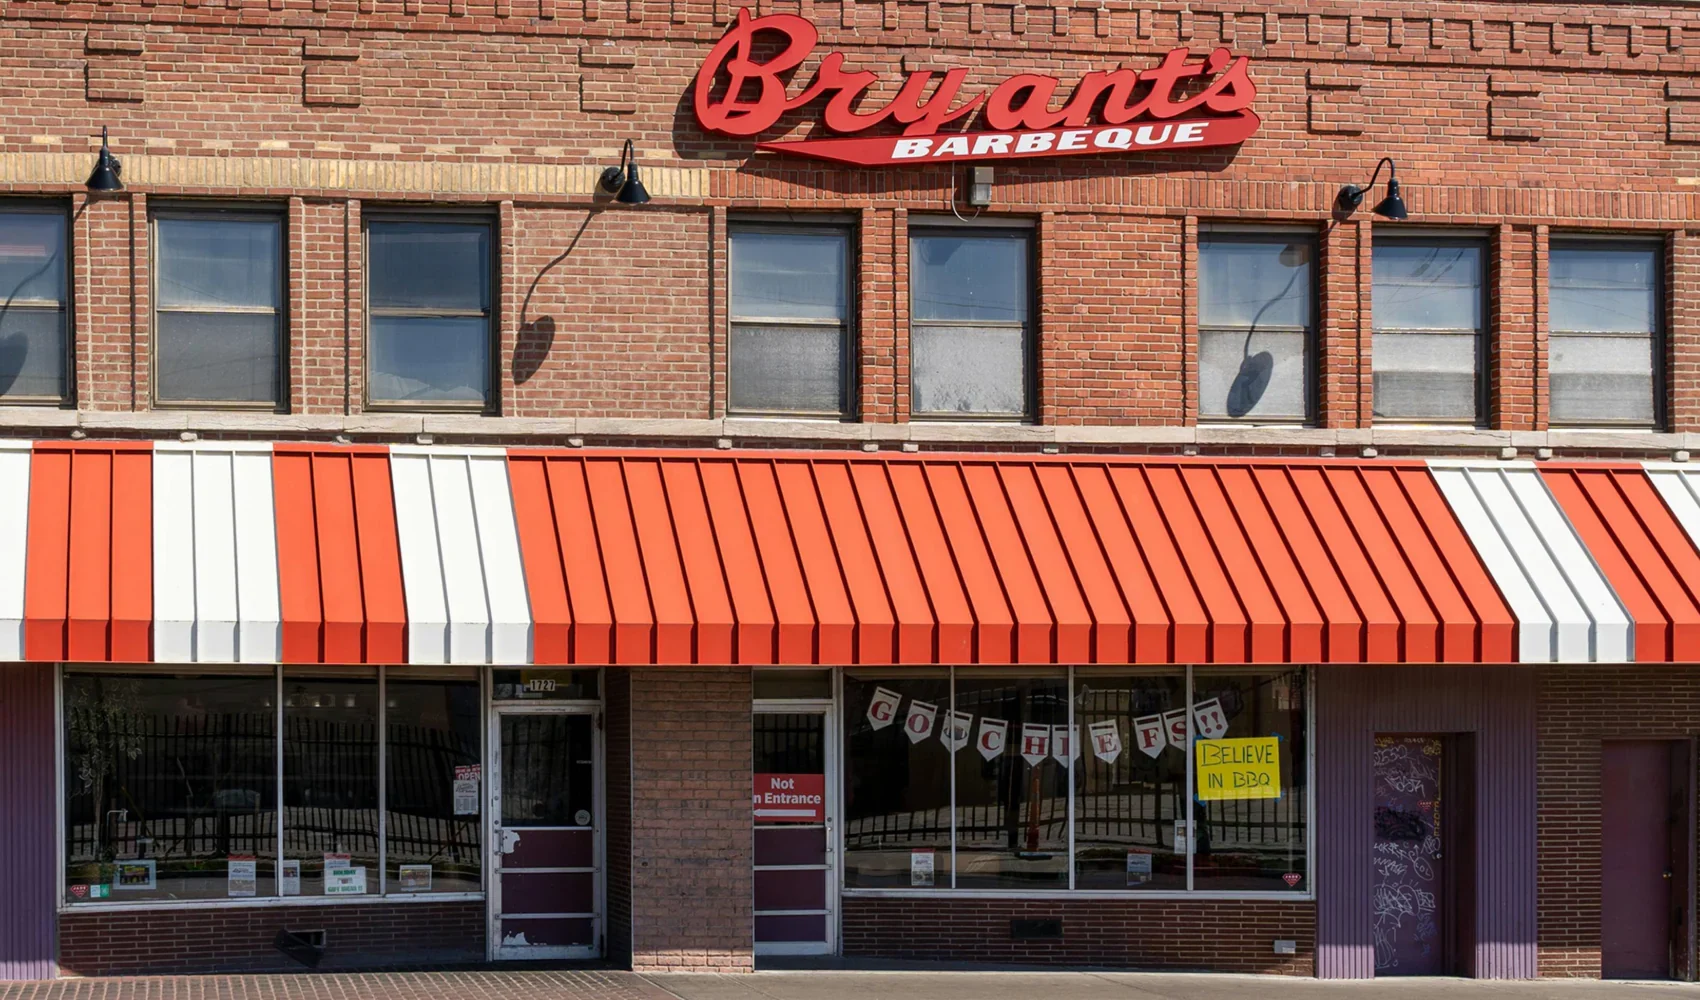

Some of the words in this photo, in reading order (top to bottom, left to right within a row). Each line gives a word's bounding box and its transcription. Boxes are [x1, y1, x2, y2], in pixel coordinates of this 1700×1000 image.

[695, 7, 1257, 136] Bryant's
[891, 122, 1210, 158] BARBEQUE
[531, 680, 555, 691] 1727
[871, 700, 930, 734] GO
[1201, 743, 1275, 767] BELIEVE
[458, 771, 481, 781] OPEN
[771, 777, 794, 789] Not
[1208, 772, 1223, 788] IN
[1233, 771, 1270, 788] BBQ
[753, 794, 762, 804] n
[764, 792, 821, 804] Entrance
